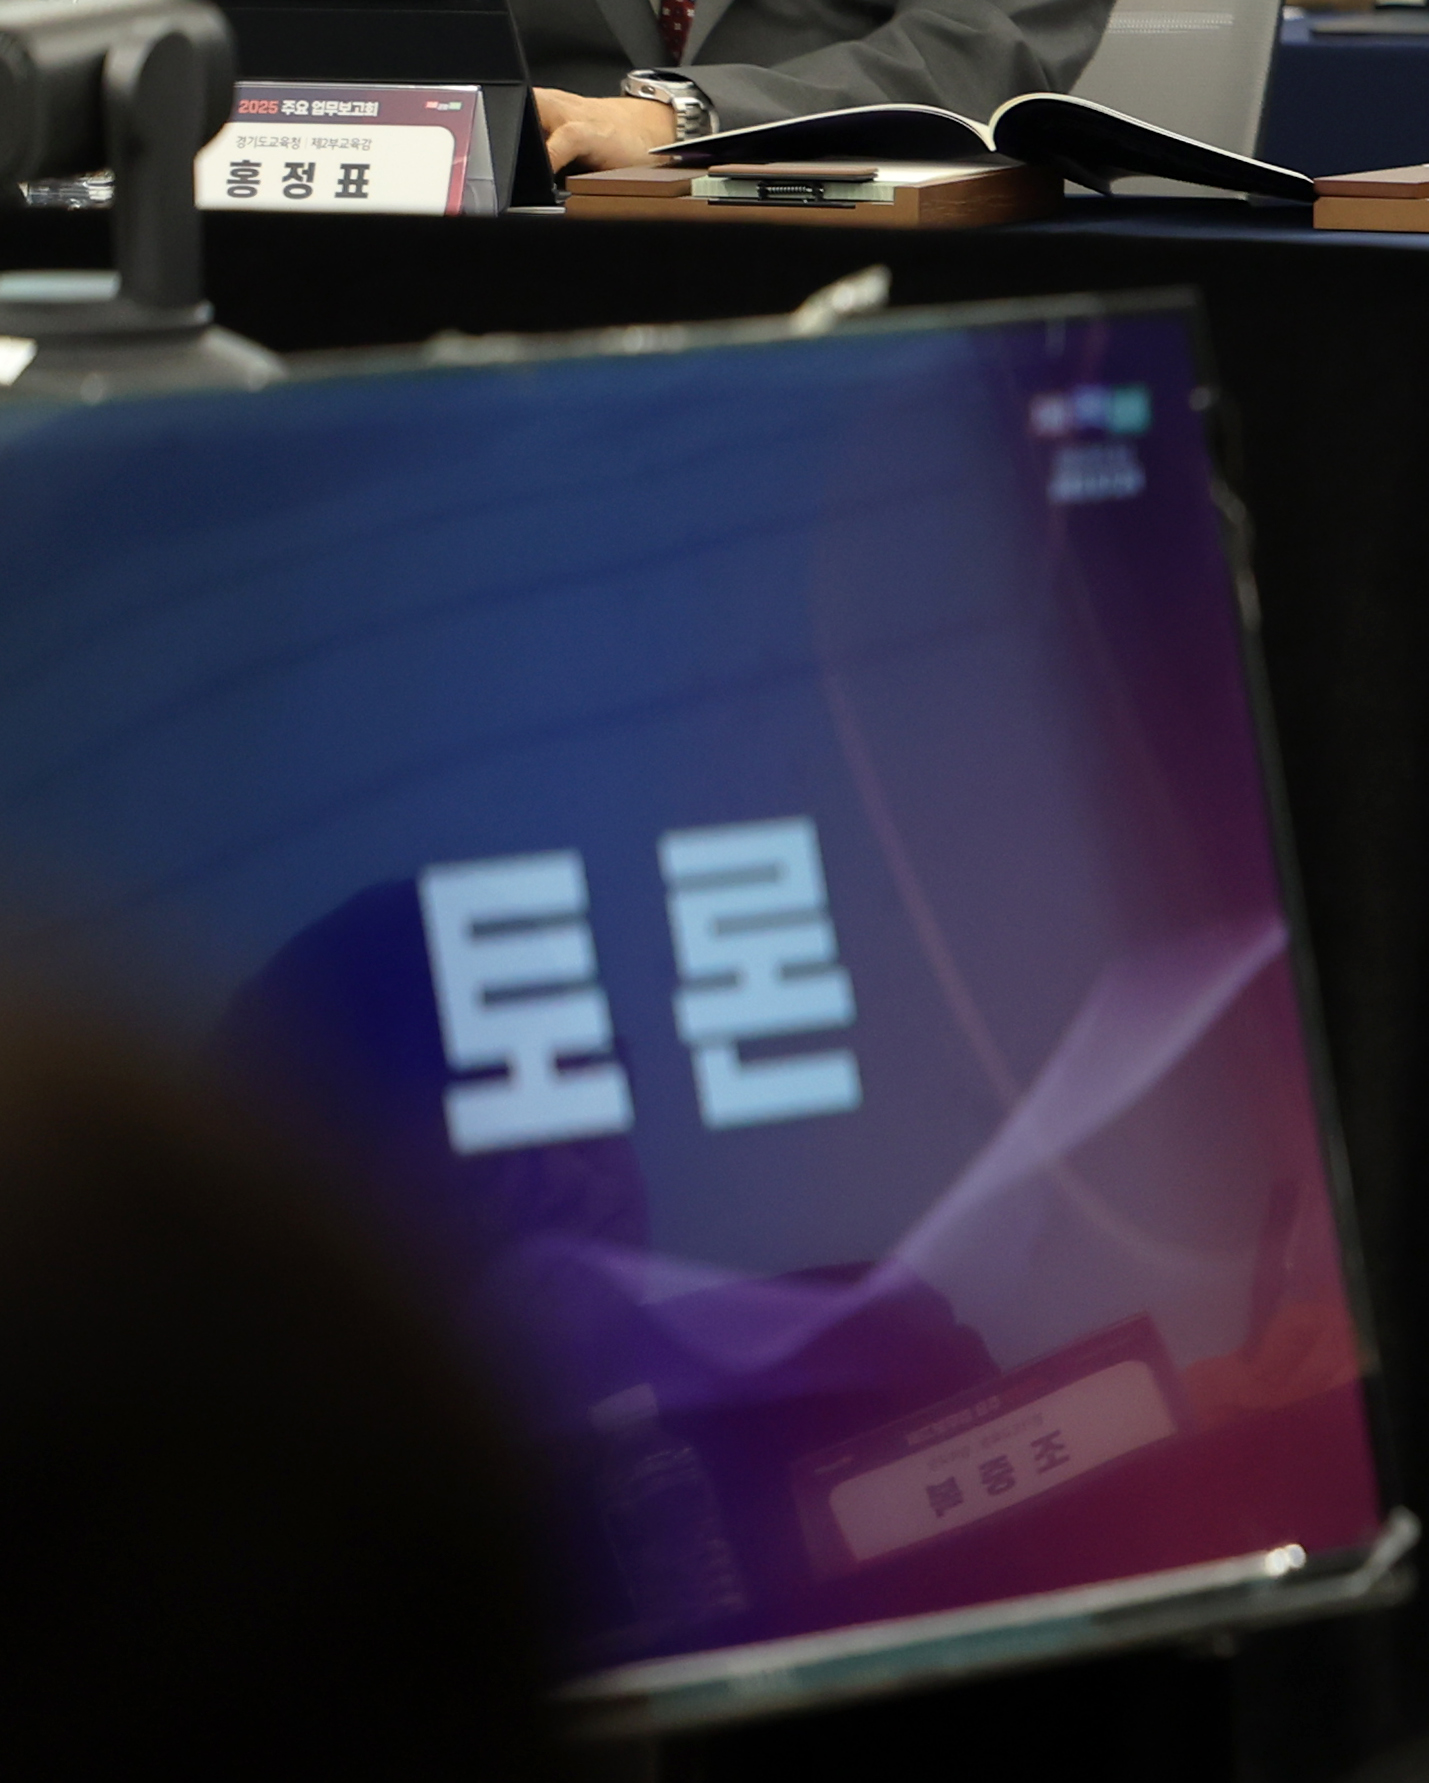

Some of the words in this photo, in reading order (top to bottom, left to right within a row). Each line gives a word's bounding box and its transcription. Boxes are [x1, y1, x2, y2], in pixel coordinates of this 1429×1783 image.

[238, 99, 279, 114] 2025
[281, 99, 309, 116] 주요
[311, 100, 379, 117] 업무보고회
[236, 135, 302, 150] 경기도교육청
[416, 816, 862, 1156] 토론
